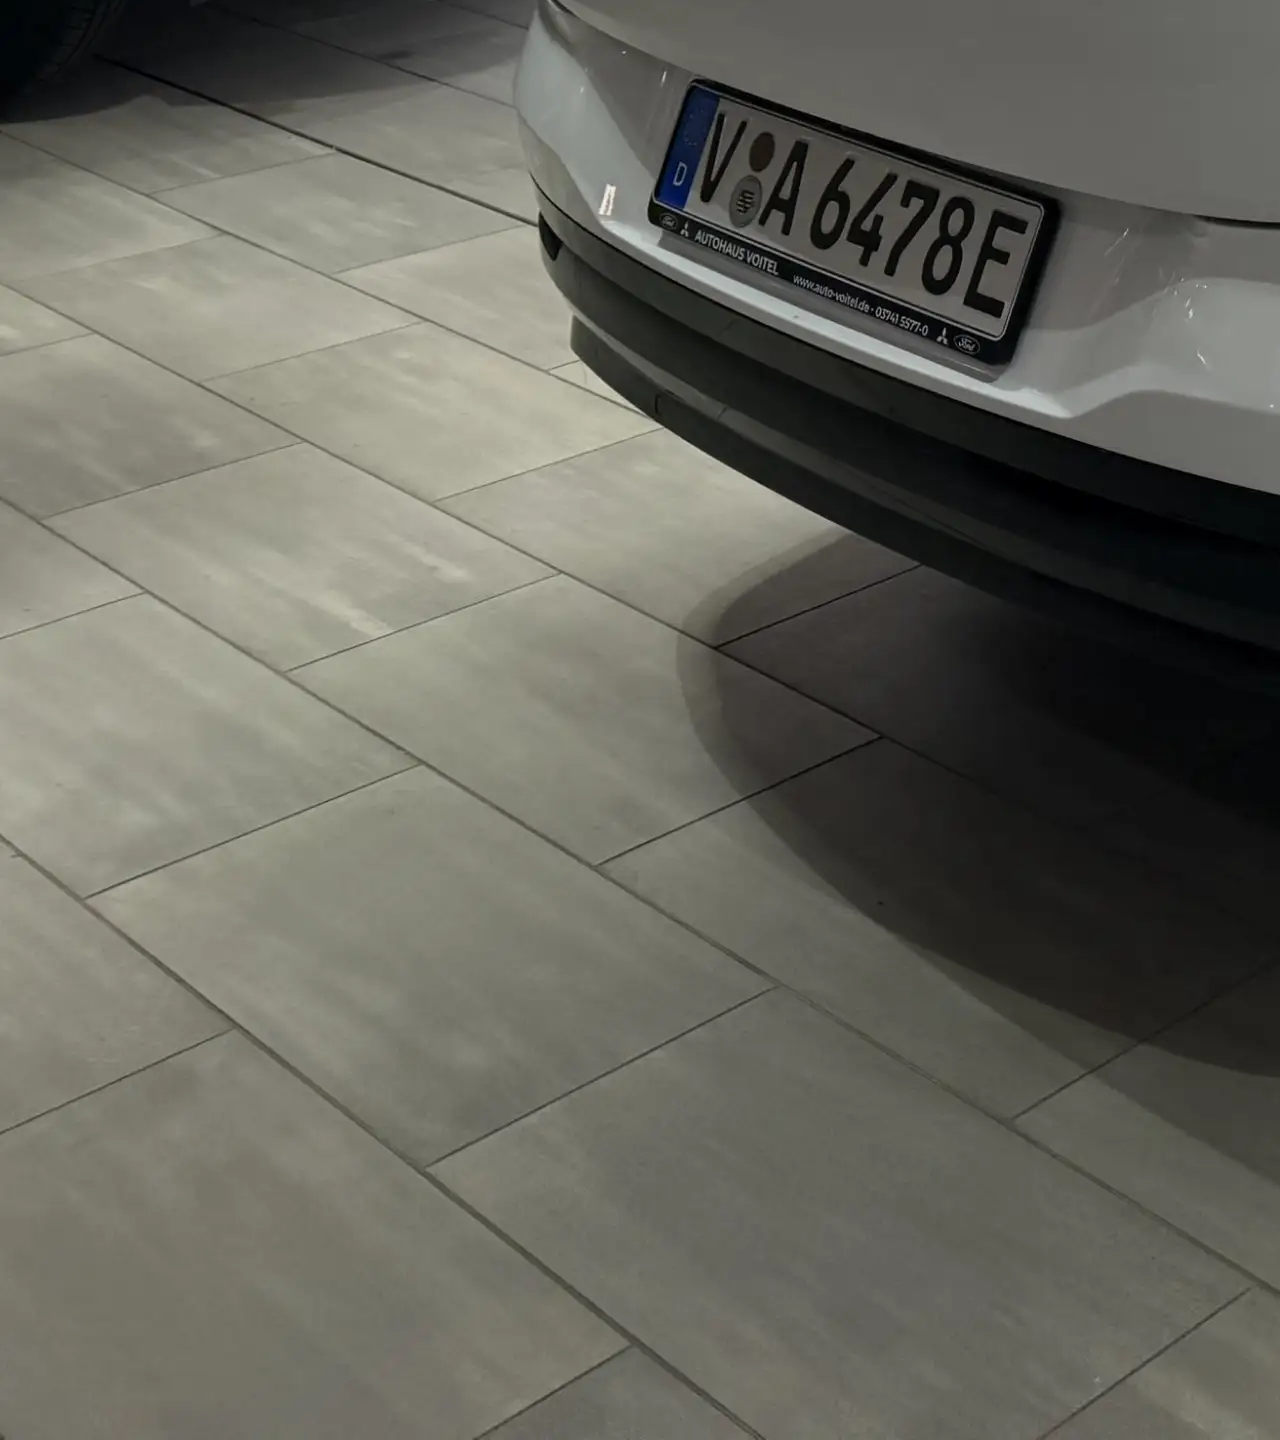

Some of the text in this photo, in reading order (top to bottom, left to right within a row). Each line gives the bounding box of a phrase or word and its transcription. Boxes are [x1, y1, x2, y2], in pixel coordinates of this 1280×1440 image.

[672, 162, 686, 187] D
[699, 112, 1030, 319] V A 6478E
[694, 229, 746, 262] AUTOHAUS
[746, 249, 780, 276] VOITEL
[792, 274, 870, 314] www.auto-voitel.de
